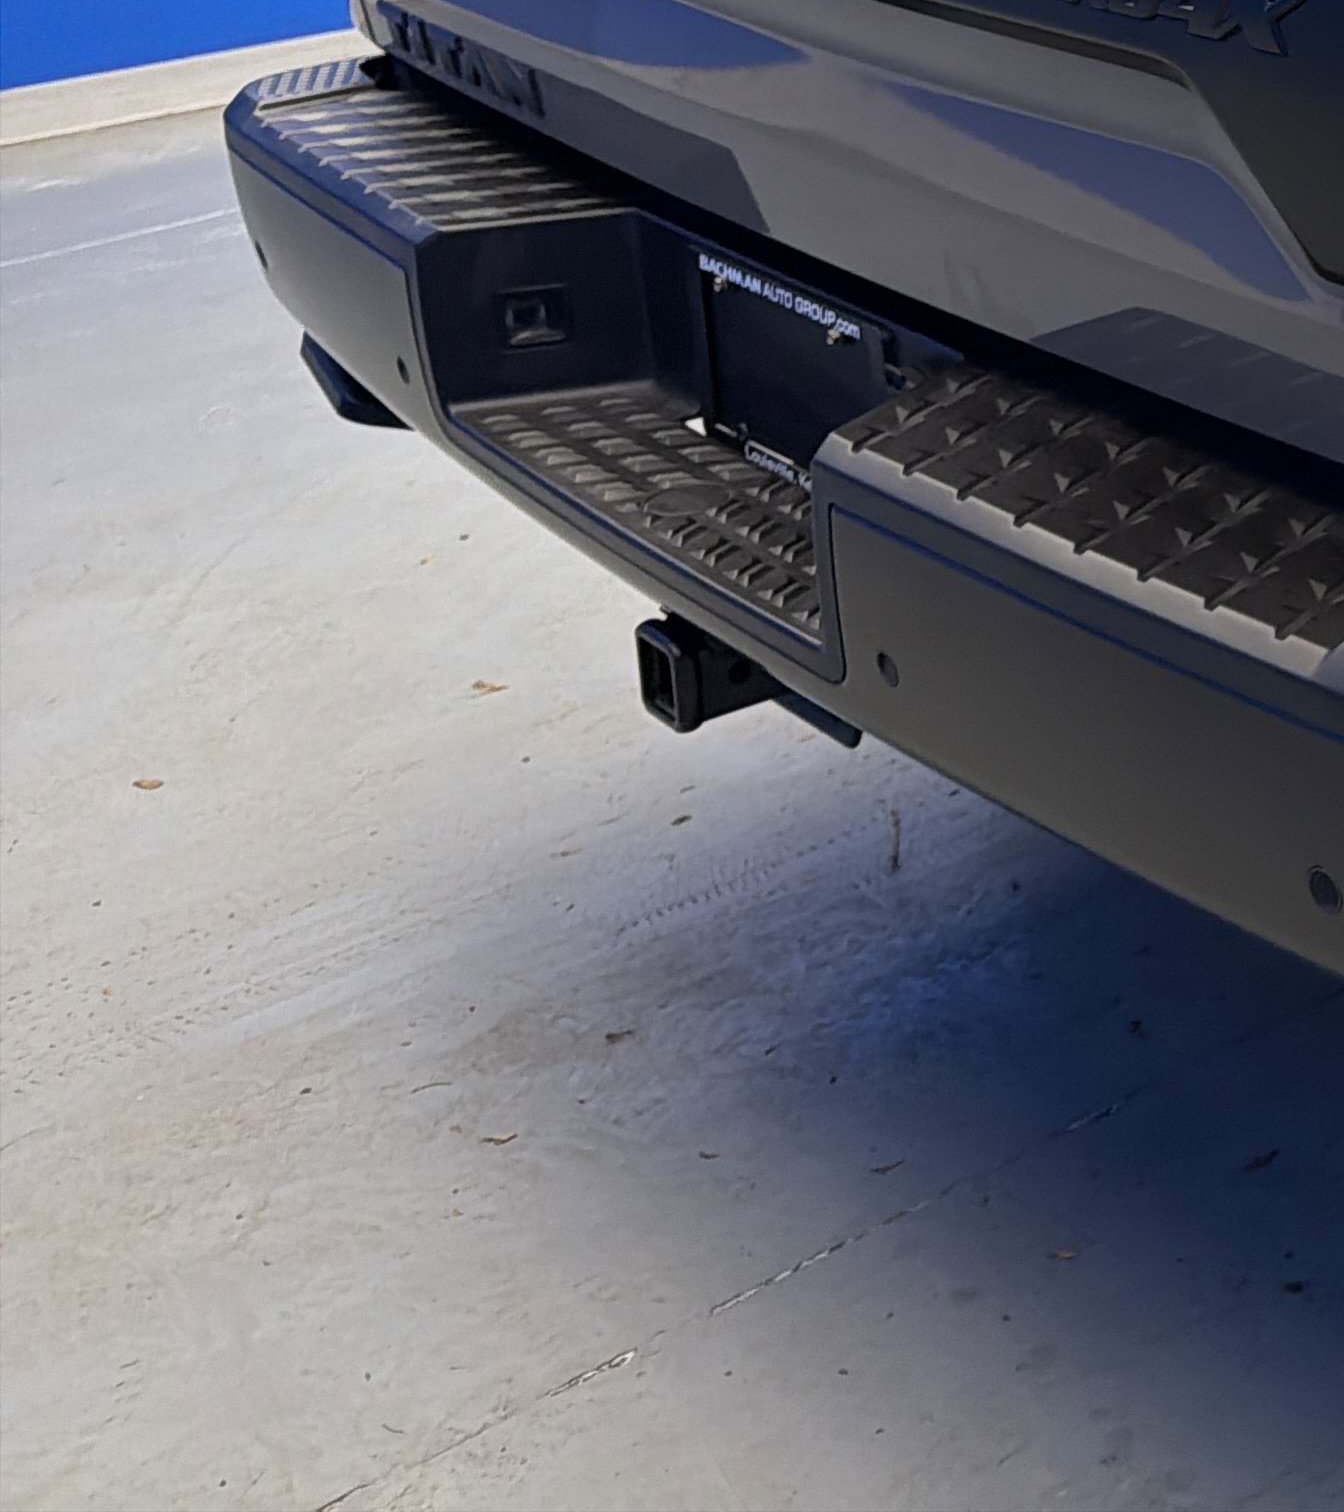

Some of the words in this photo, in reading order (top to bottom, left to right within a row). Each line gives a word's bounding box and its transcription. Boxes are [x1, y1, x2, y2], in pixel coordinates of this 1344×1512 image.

[377, 0, 546, 118] TITAN
[699, 254, 761, 295] BACHMAN
[762, 282, 793, 310] AUTO
